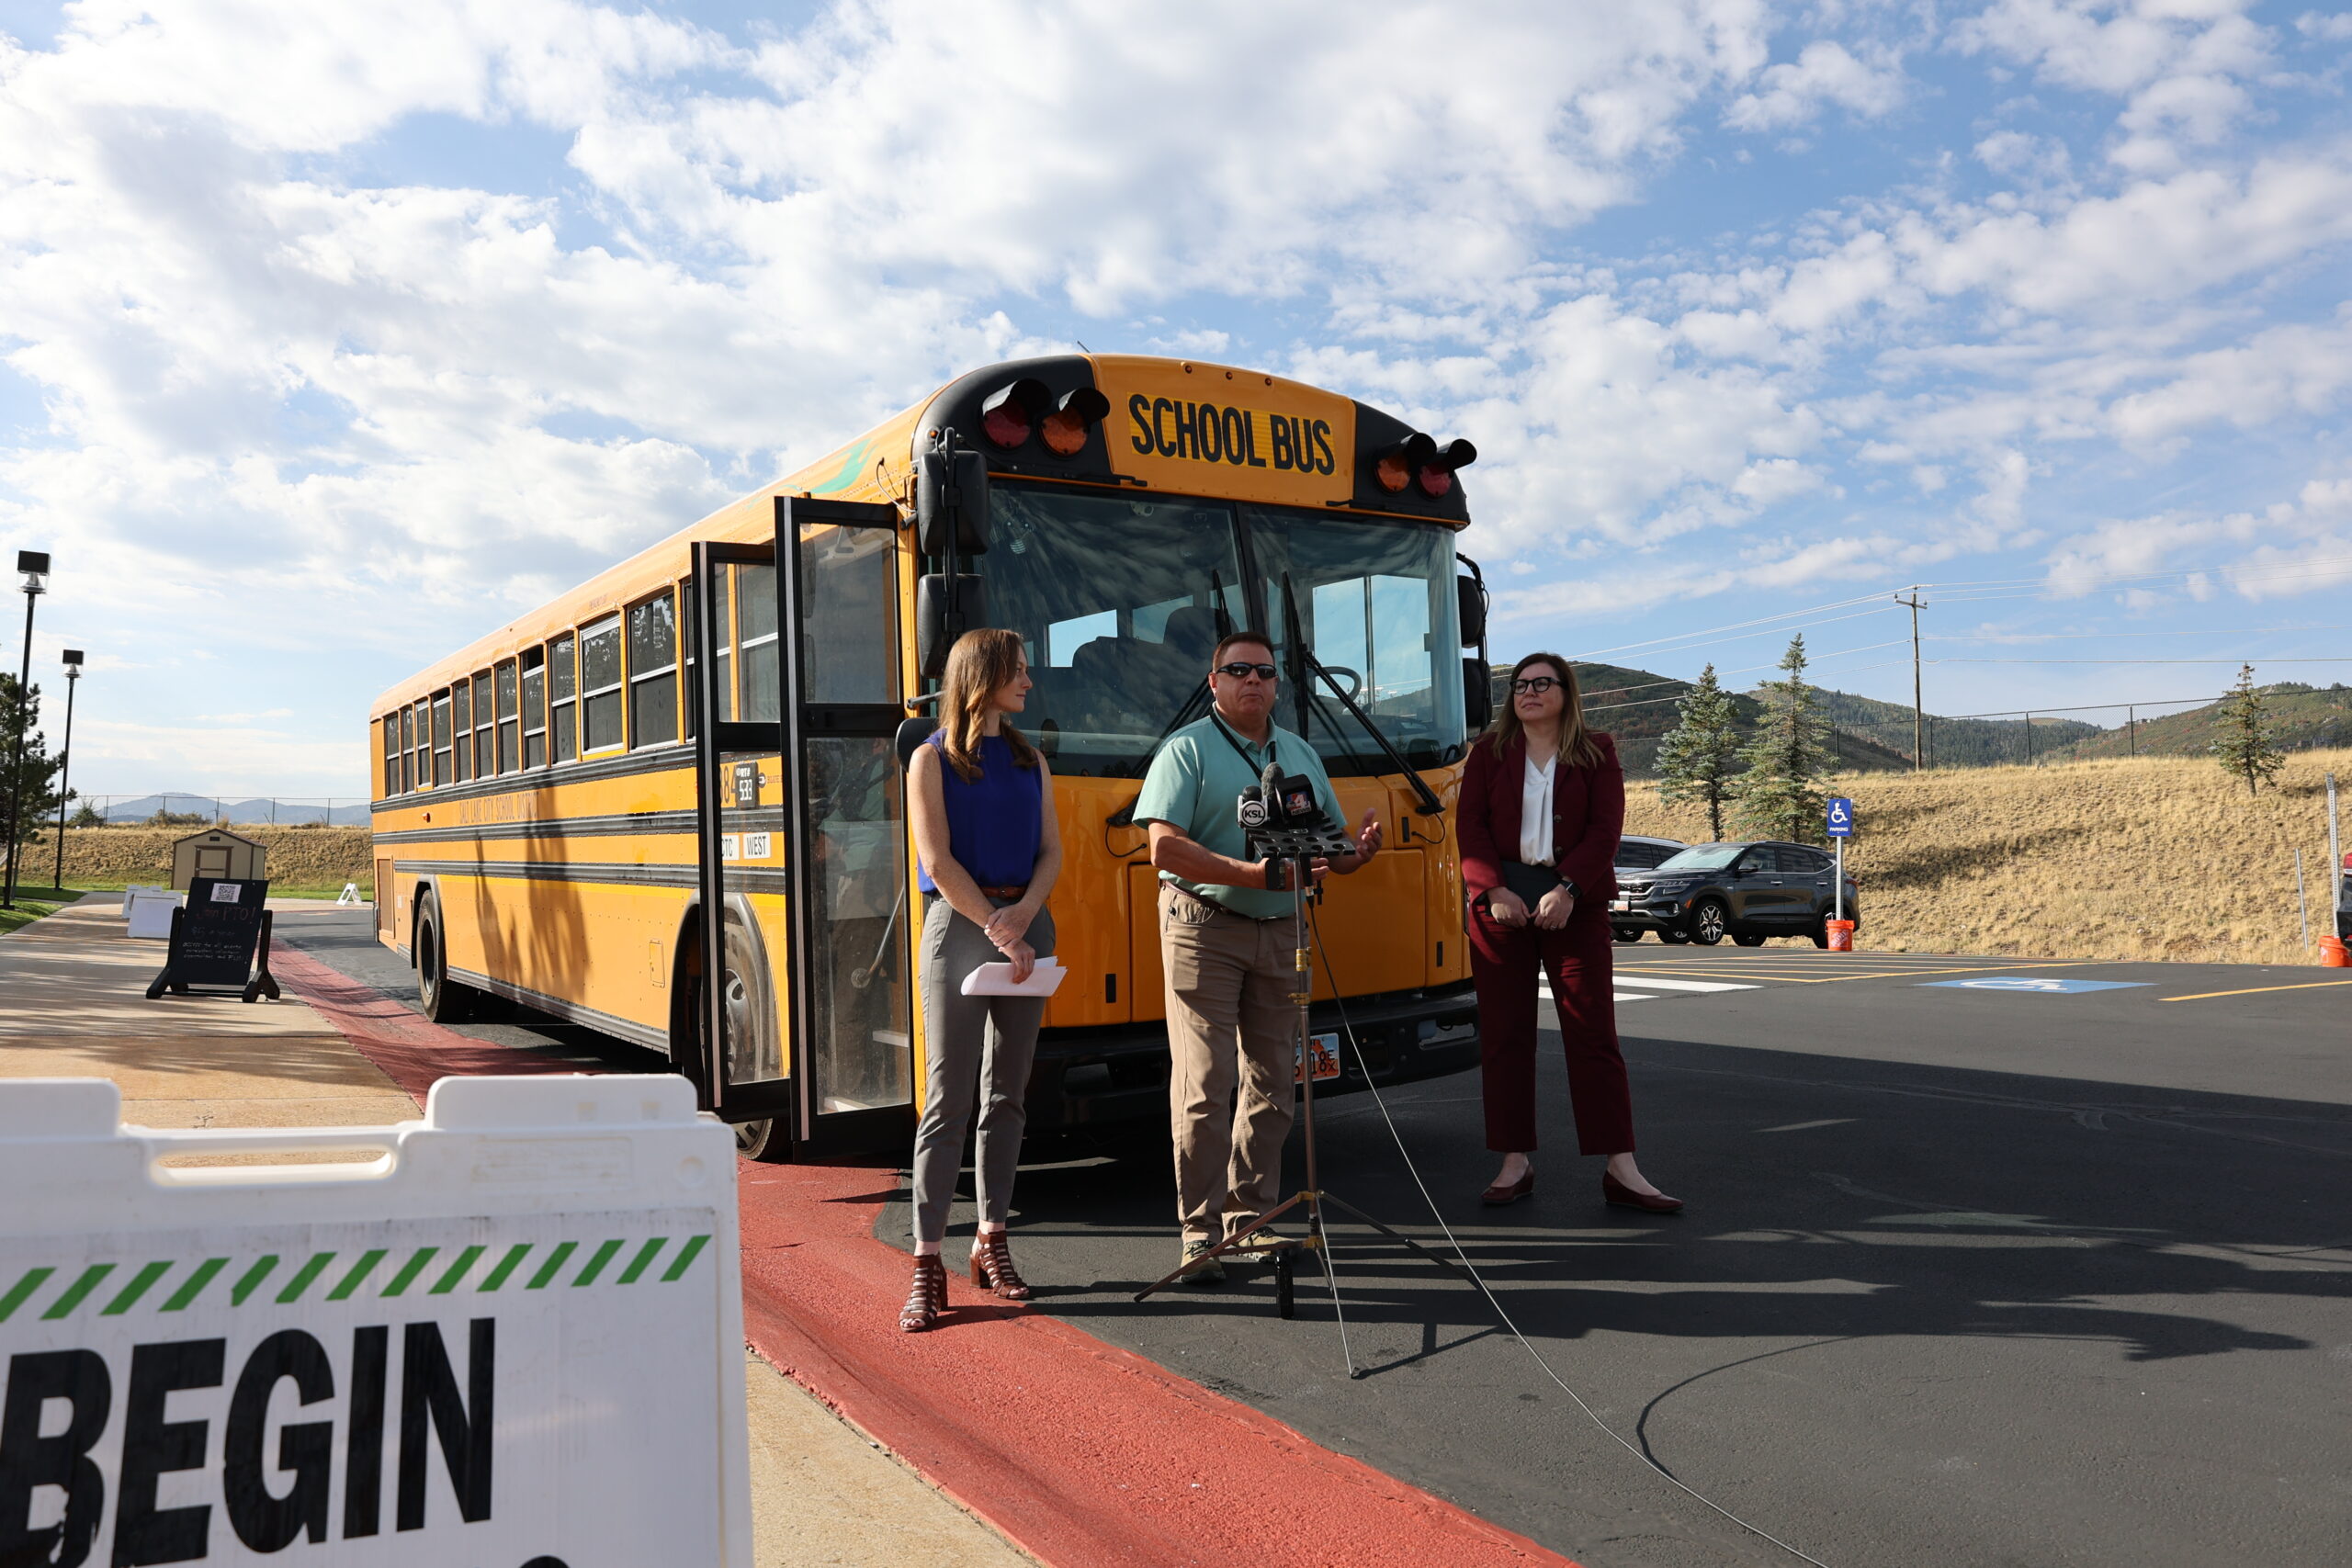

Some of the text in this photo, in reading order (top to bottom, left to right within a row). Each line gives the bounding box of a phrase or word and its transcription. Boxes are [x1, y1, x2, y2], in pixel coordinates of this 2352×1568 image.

[1128, 394, 1335, 476] SCHOOL BUS
[496, 795, 514, 820] SCHOOL
[1244, 809, 1265, 818] KSL
[746, 835, 766, 855] WEST
[0, 1317, 495, 1568] BEGIN
